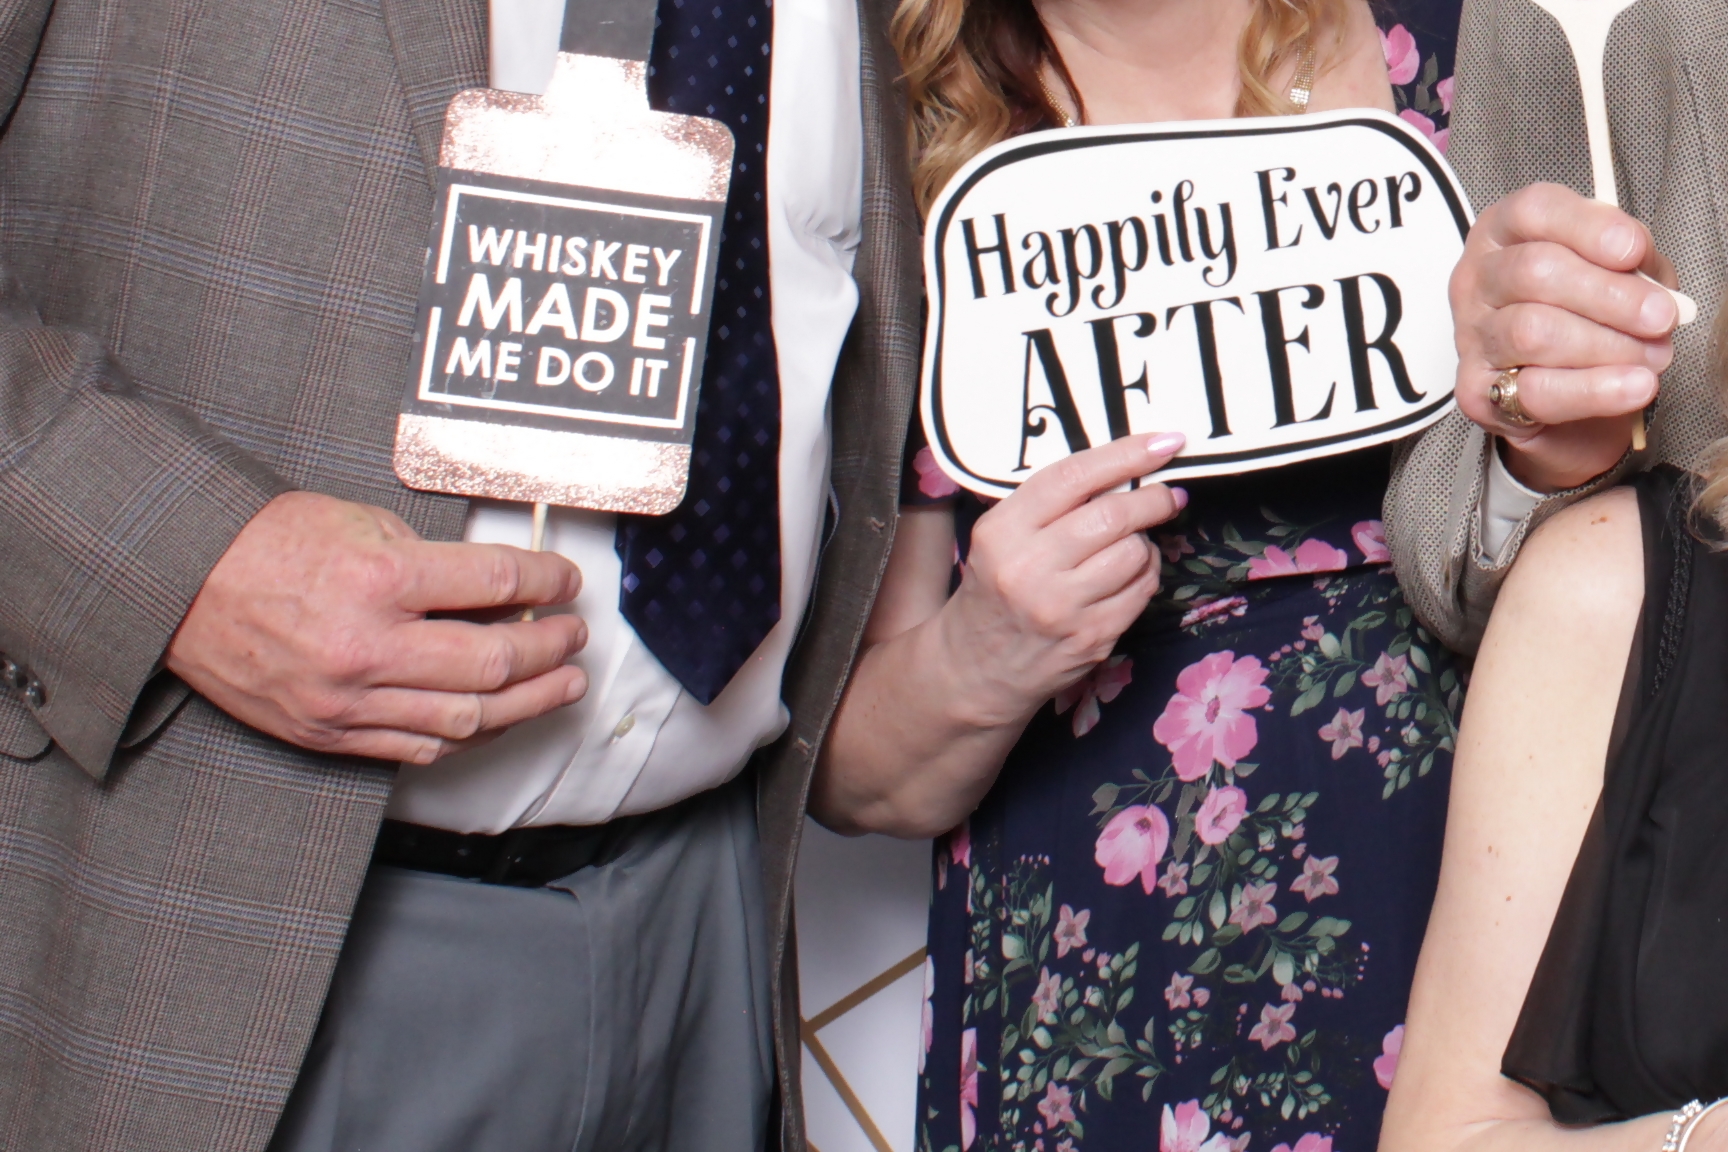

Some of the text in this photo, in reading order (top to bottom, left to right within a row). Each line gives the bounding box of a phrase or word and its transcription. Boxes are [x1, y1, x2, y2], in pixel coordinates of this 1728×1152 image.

[468, 224, 682, 286] WHISKEY
[959, 166, 1422, 317] Happily Ever
[457, 273, 672, 350] MADE
[445, 337, 669, 398] ME DO IT
[1011, 271, 1428, 473] AFTER
